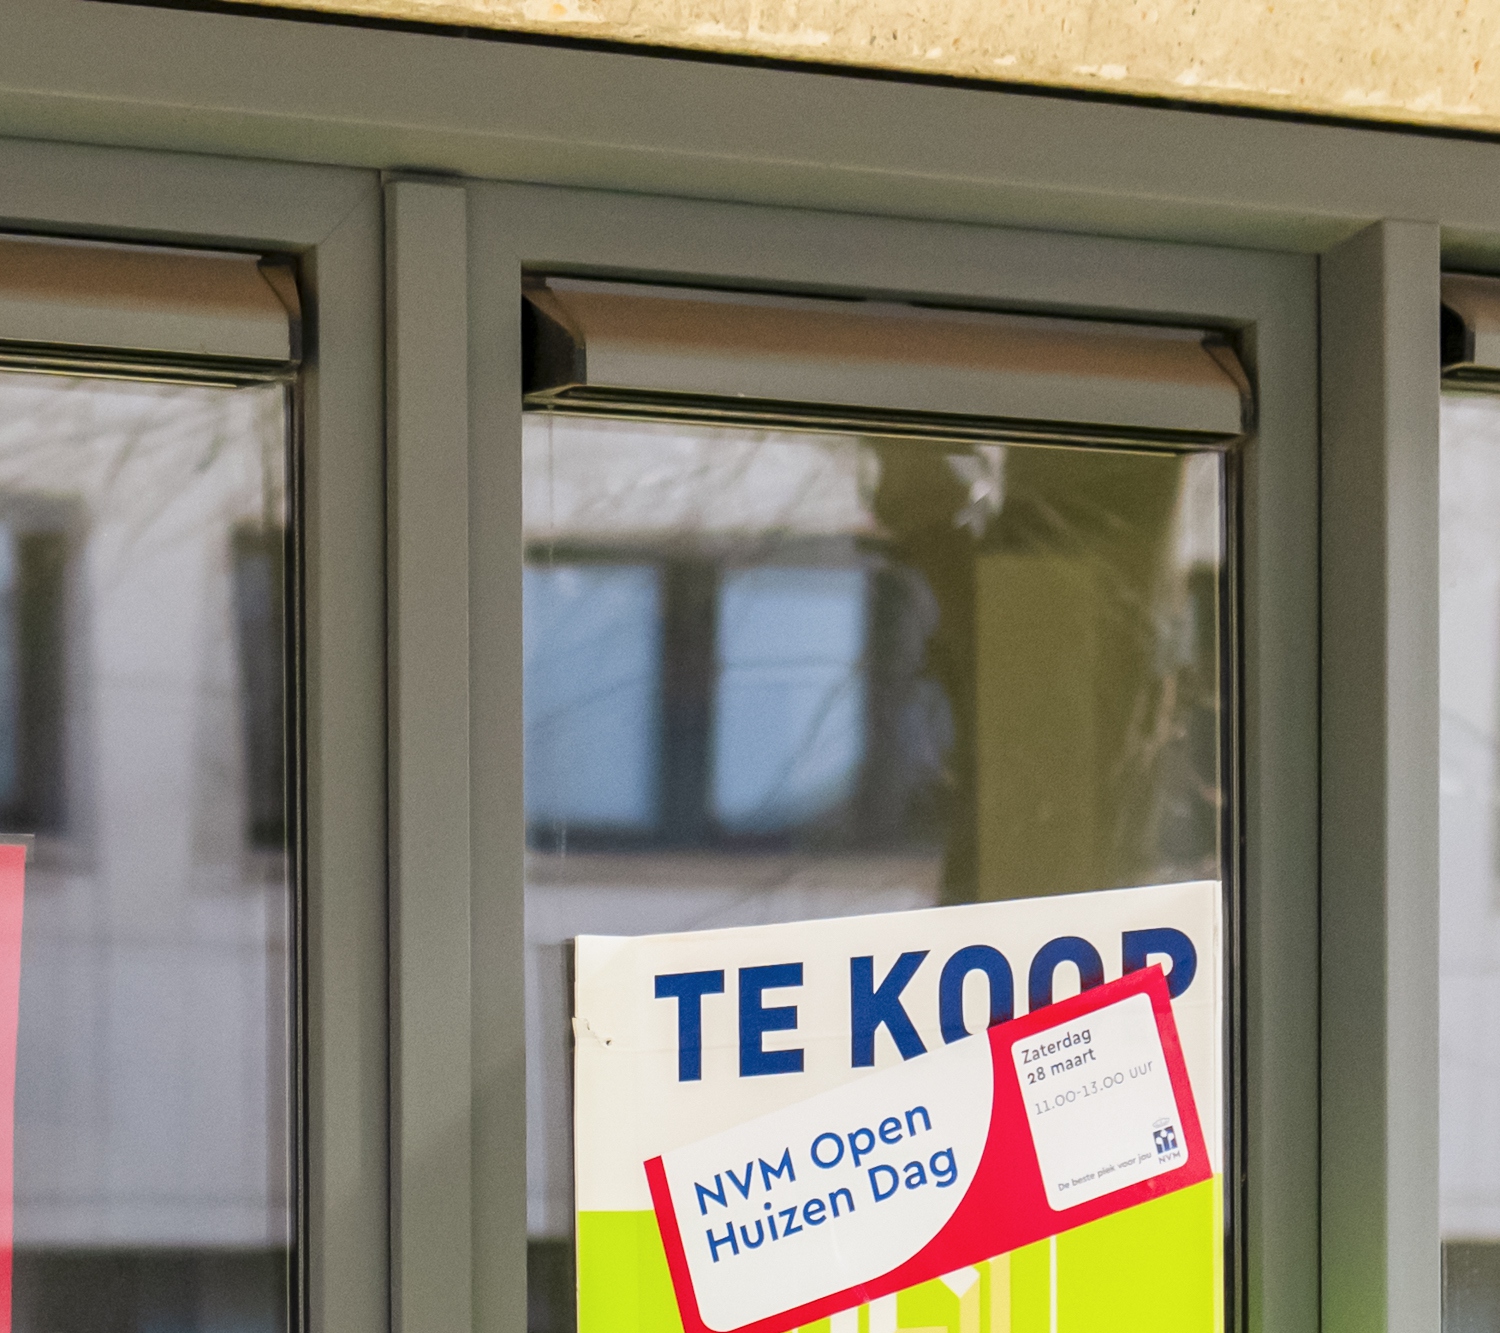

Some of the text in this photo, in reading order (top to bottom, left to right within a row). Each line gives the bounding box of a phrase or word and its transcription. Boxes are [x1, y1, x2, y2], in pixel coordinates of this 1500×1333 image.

[655, 961, 805, 1082] TE
[1021, 1029, 1093, 1065] Zaterdag
[1028, 1048, 1097, 1085] 28 maart
[1034, 1061, 1153, 1115] 11.00-13.00 uur
[694, 1105, 932, 1216] NVM Open
[705, 1147, 958, 1263] Huizen Dag
